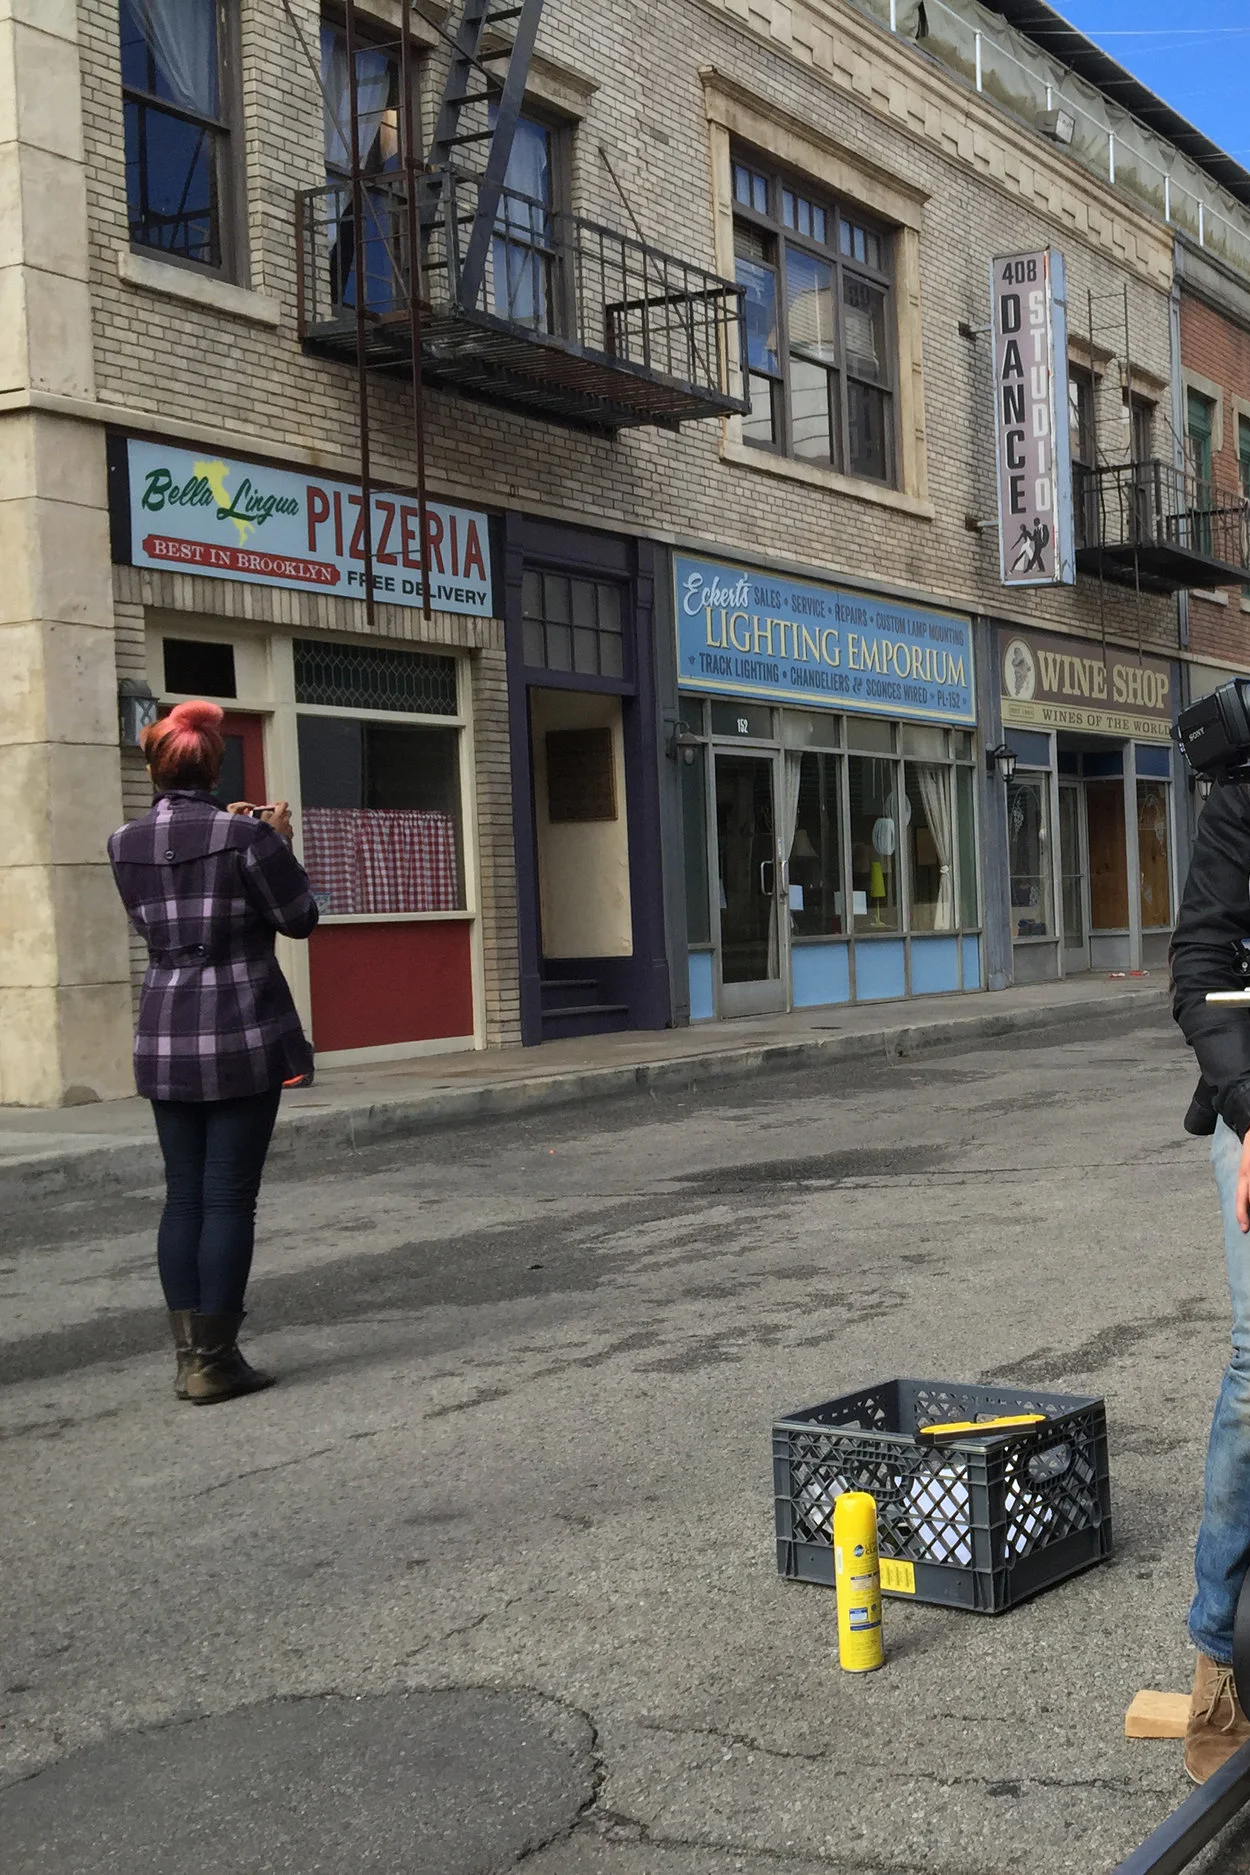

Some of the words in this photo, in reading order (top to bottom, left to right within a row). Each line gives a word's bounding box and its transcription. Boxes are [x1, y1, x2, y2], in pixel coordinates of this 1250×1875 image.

[1001, 259, 1037, 285] 408
[1000, 293, 1026, 515] DANCE
[1028, 290, 1050, 513] STUDIO
[142, 468, 213, 512] Bella
[217, 478, 299, 525] Lingua
[153, 539, 203, 561] BEST
[210, 549, 230, 565] IN
[237, 553, 333, 582] BROOKLYN
[306, 485, 487, 581] PIZZERIA
[682, 571, 752, 616] Eckert's
[754, 586, 782, 609] SALES
[791, 596, 825, 618] SERVICE
[834, 604, 868, 626] REPAIRS
[876, 612, 905, 634] CUSTOM
[906, 617, 927, 638] LAMP
[929, 622, 964, 646] MOUNTING
[705, 606, 842, 667] LIGHTING
[847, 632, 967, 688] EMPORIUM
[699, 652, 733, 677] TRACK
[735, 658, 779, 683] LIGHTING
[790, 666, 850, 692] CHANDELIERS
[853, 677, 863, 695] &
[866, 680, 901, 700] SCONCES
[903, 685, 928, 705] WIRED
[1037, 650, 1108, 700] WINE
[1112, 664, 1169, 709] SHOP
[737, 718, 748, 733] 152
[1042, 708, 1083, 725] WINES
[1087, 715, 1103, 726] OF
[1106, 717, 1129, 730] THE
[1133, 721, 1171, 736] WORLD
[1189, 727, 1204, 741] SONY
